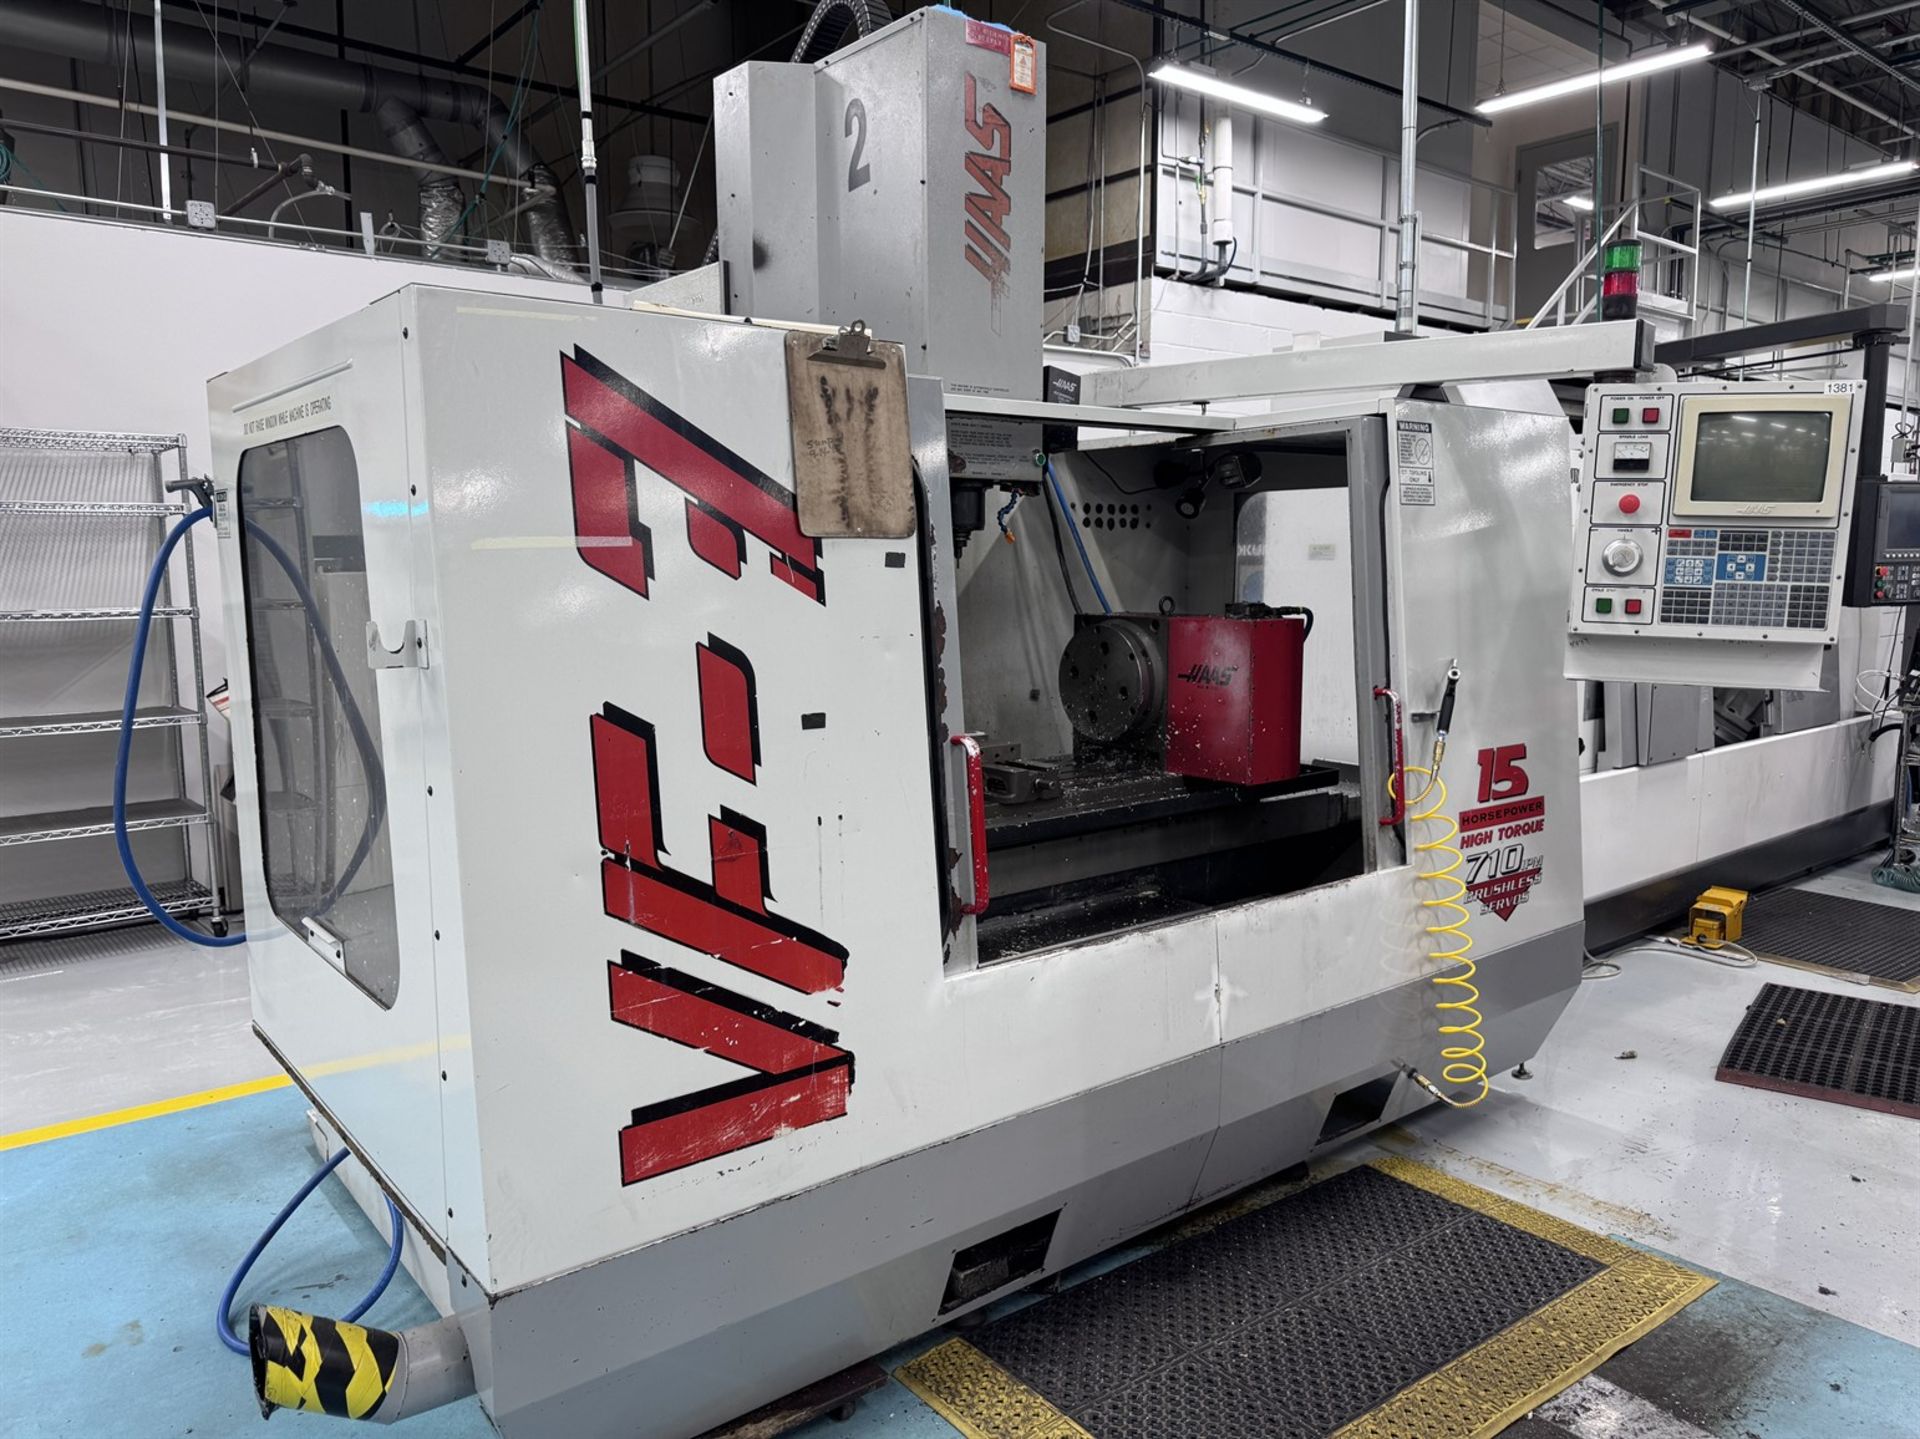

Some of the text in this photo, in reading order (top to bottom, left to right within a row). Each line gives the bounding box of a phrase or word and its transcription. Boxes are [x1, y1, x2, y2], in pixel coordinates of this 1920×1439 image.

[844, 98, 871, 193] 2
[964, 71, 1011, 320] HAAS
[1052, 378, 1077, 392] HAAS
[1827, 383, 1854, 394] 1381
[1399, 422, 1430, 433] WARNING
[1177, 664, 1239, 687] HAAS
[1477, 743, 1530, 804] 15
[1462, 801, 1543, 826] HORSEPOWER
[1460, 819, 1545, 850] HIGH TORQUE
[1465, 843, 1525, 885] 710
[1463, 871, 1543, 905] BRUSHLESS
[1479, 890, 1530, 916] SERVOS
